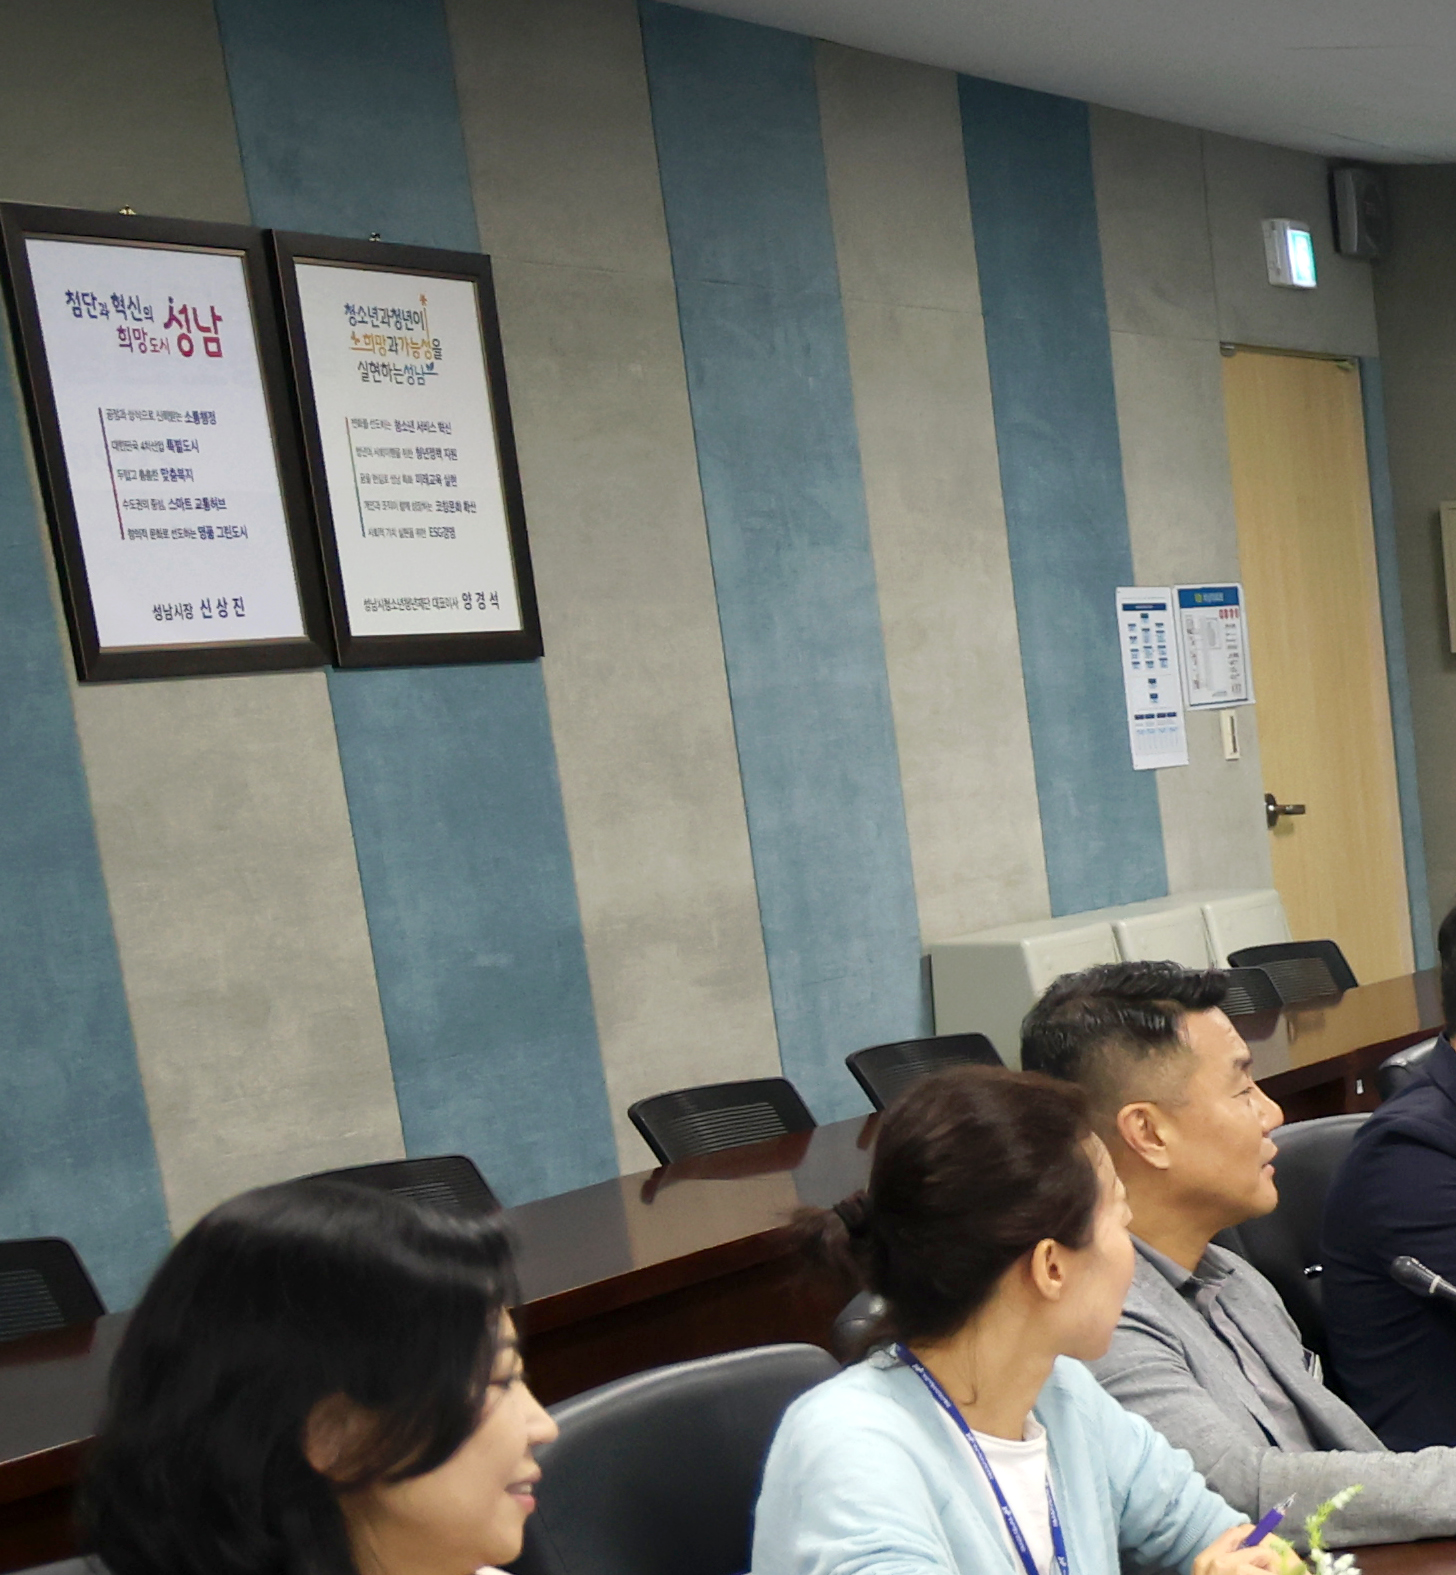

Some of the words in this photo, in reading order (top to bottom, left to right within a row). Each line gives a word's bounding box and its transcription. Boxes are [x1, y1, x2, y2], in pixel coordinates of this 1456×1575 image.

[65, 289, 110, 320] 첨단과
[110, 292, 154, 323] 혁신의
[163, 296, 223, 358] 성남
[168, 496, 193, 511] 스마트
[152, 602, 193, 621] 성남시장
[200, 596, 245, 619] 신상진
